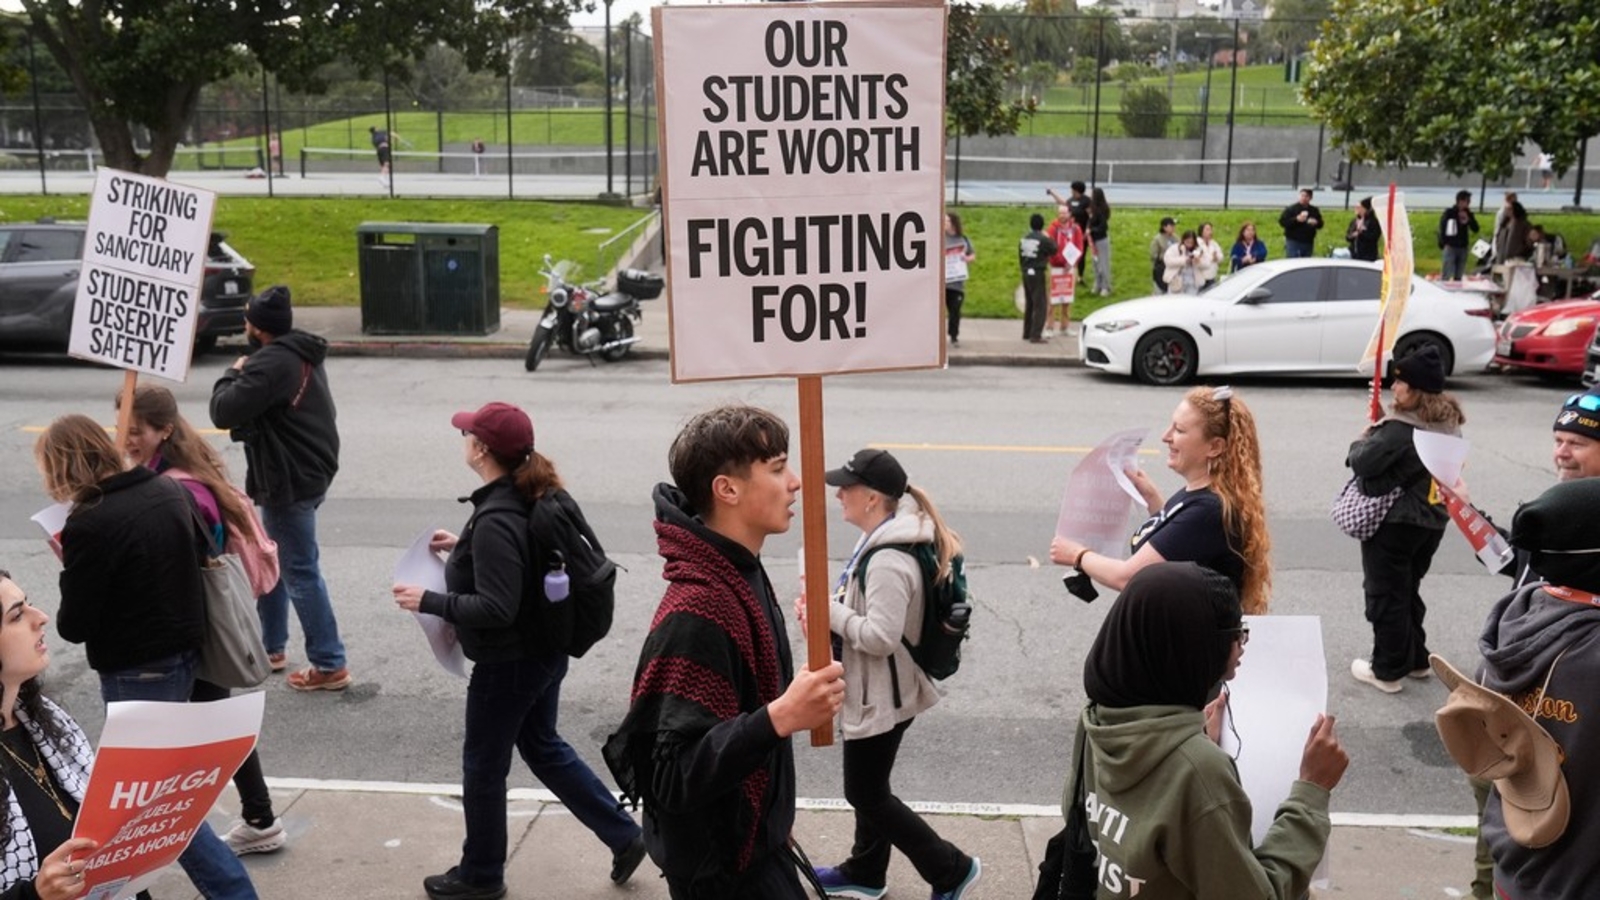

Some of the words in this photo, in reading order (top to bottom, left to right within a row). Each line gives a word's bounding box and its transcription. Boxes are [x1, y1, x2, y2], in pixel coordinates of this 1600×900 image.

[764, 20, 848, 68] OUR
[702, 73, 909, 123] STUDENTS
[691, 129, 770, 177] ARE
[777, 126, 920, 175] WORTH
[107, 176, 198, 221] STRIKING
[128, 210, 168, 243] FOR
[687, 211, 927, 279] FIGHTING
[94, 231, 195, 275] SANCTUARY
[87, 268, 189, 318] STUDENTS
[752, 281, 867, 343] FOR!
[89, 298, 178, 345] DESERVE
[89, 327, 170, 372] SAFETY!
[1522, 687, 1578, 723] sion
[109, 767, 221, 810] HUELGA
[169, 815, 183, 829] Y
[85, 846, 133, 870] ABLES
[131, 829, 191, 856] AHORA!
